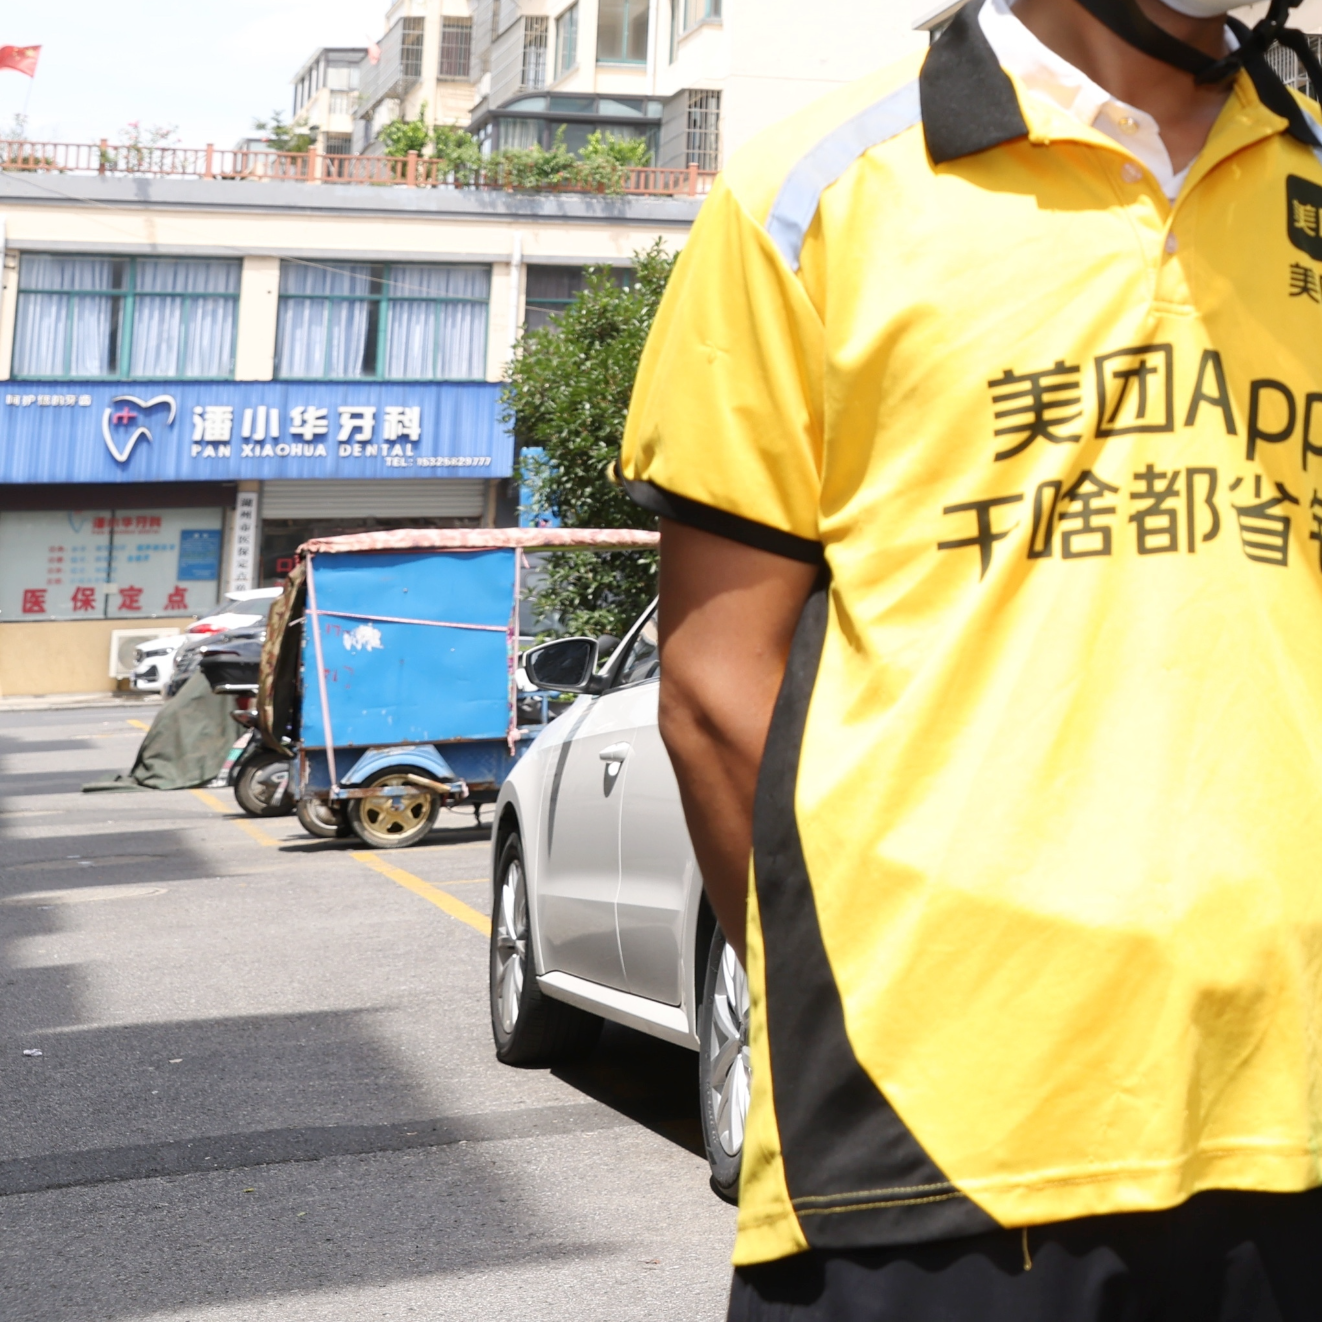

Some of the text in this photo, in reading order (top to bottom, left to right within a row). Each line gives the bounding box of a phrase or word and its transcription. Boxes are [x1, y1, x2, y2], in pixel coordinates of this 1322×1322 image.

[193, 405, 421, 441] 潘小华牙科
[191, 443, 414, 458] PAN XIAOHUA DENTAL
[22, 584, 188, 614] 医保定点
